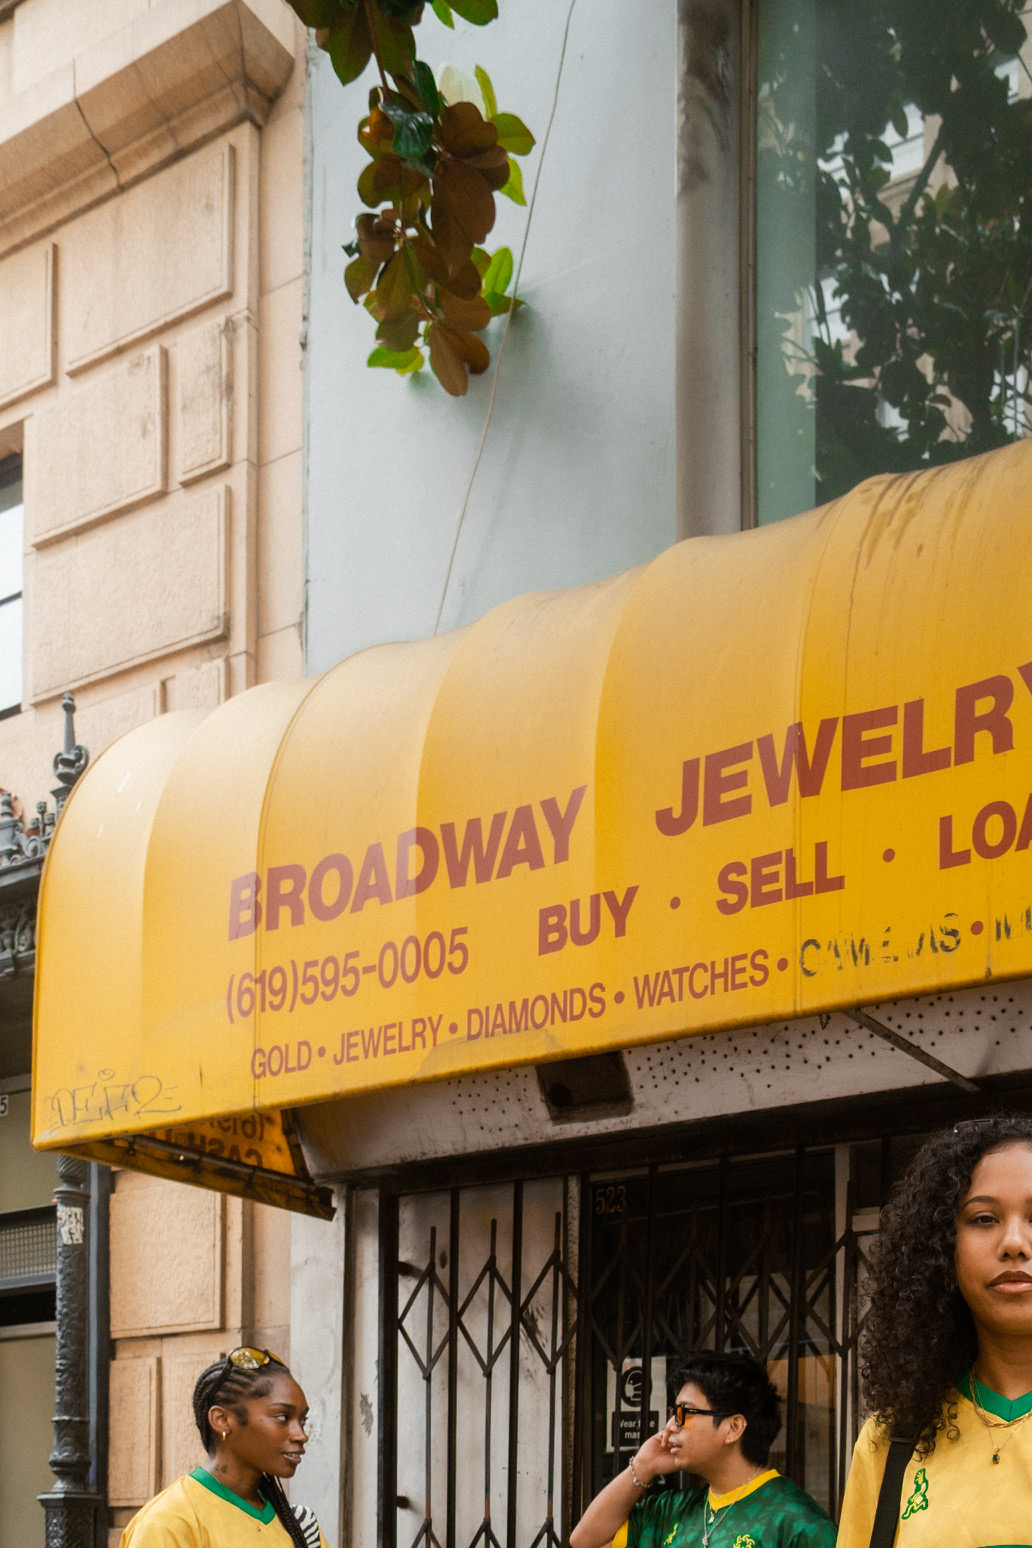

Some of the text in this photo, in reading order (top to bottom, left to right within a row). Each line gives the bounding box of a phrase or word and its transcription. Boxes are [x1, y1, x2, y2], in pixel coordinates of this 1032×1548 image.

[227, 785, 588, 941] BROADWAY
[537, 886, 639, 956] BUY
[716, 842, 844, 915] SELL
[226, 927, 469, 1024] (619)595-0005
[250, 1040, 312, 1079] GOLD
[333, 1014, 443, 1067] JEWELRY
[466, 982, 606, 1041] DIAMONDS
[633, 949, 769, 1010] WATCHES
[595, 1185, 627, 1214] 523
